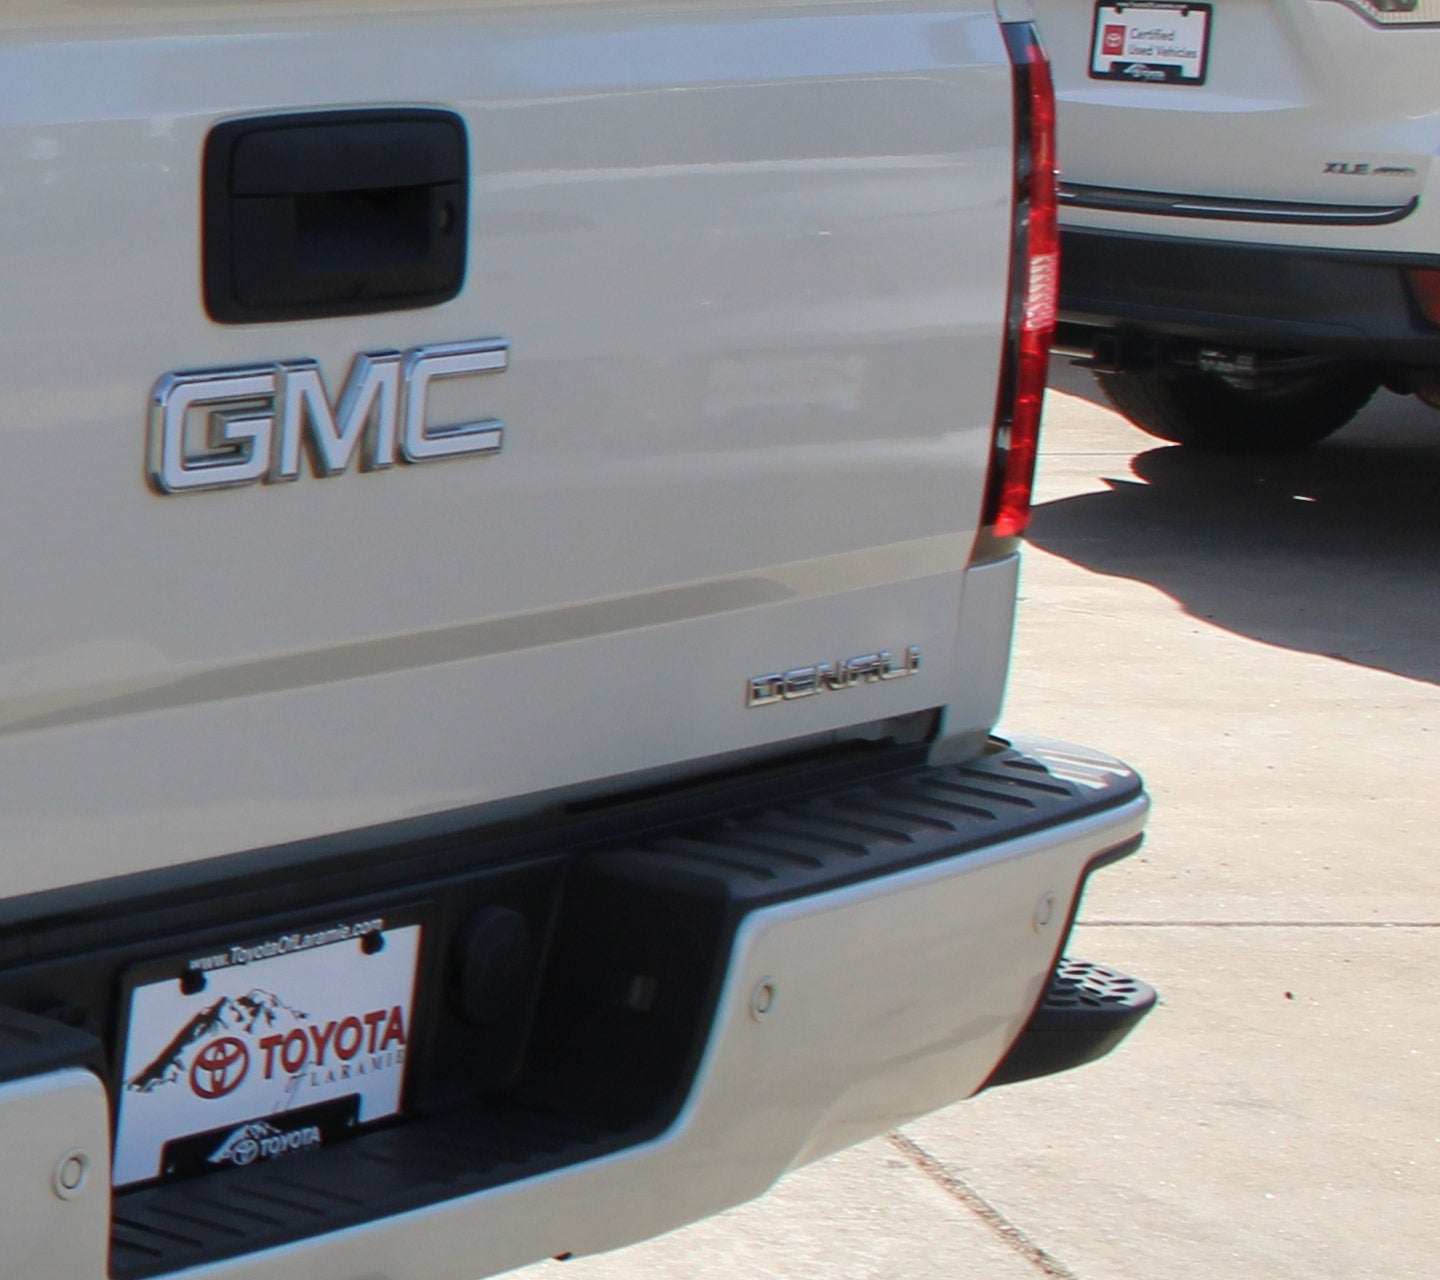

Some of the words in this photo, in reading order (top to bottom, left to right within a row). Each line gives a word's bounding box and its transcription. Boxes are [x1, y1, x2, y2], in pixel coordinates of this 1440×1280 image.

[1129, 27, 1174, 41] Certified
[1128, 43, 1153, 56] Used
[1155, 45, 1198, 58] Vehicles
[1322, 161, 1369, 175] XLE
[147, 336, 509, 496] GMC
[259, 1005, 407, 1080] TOYOTA
[308, 1048, 405, 1087] LARAMIE
[260, 1126, 322, 1157] TOYOTA
